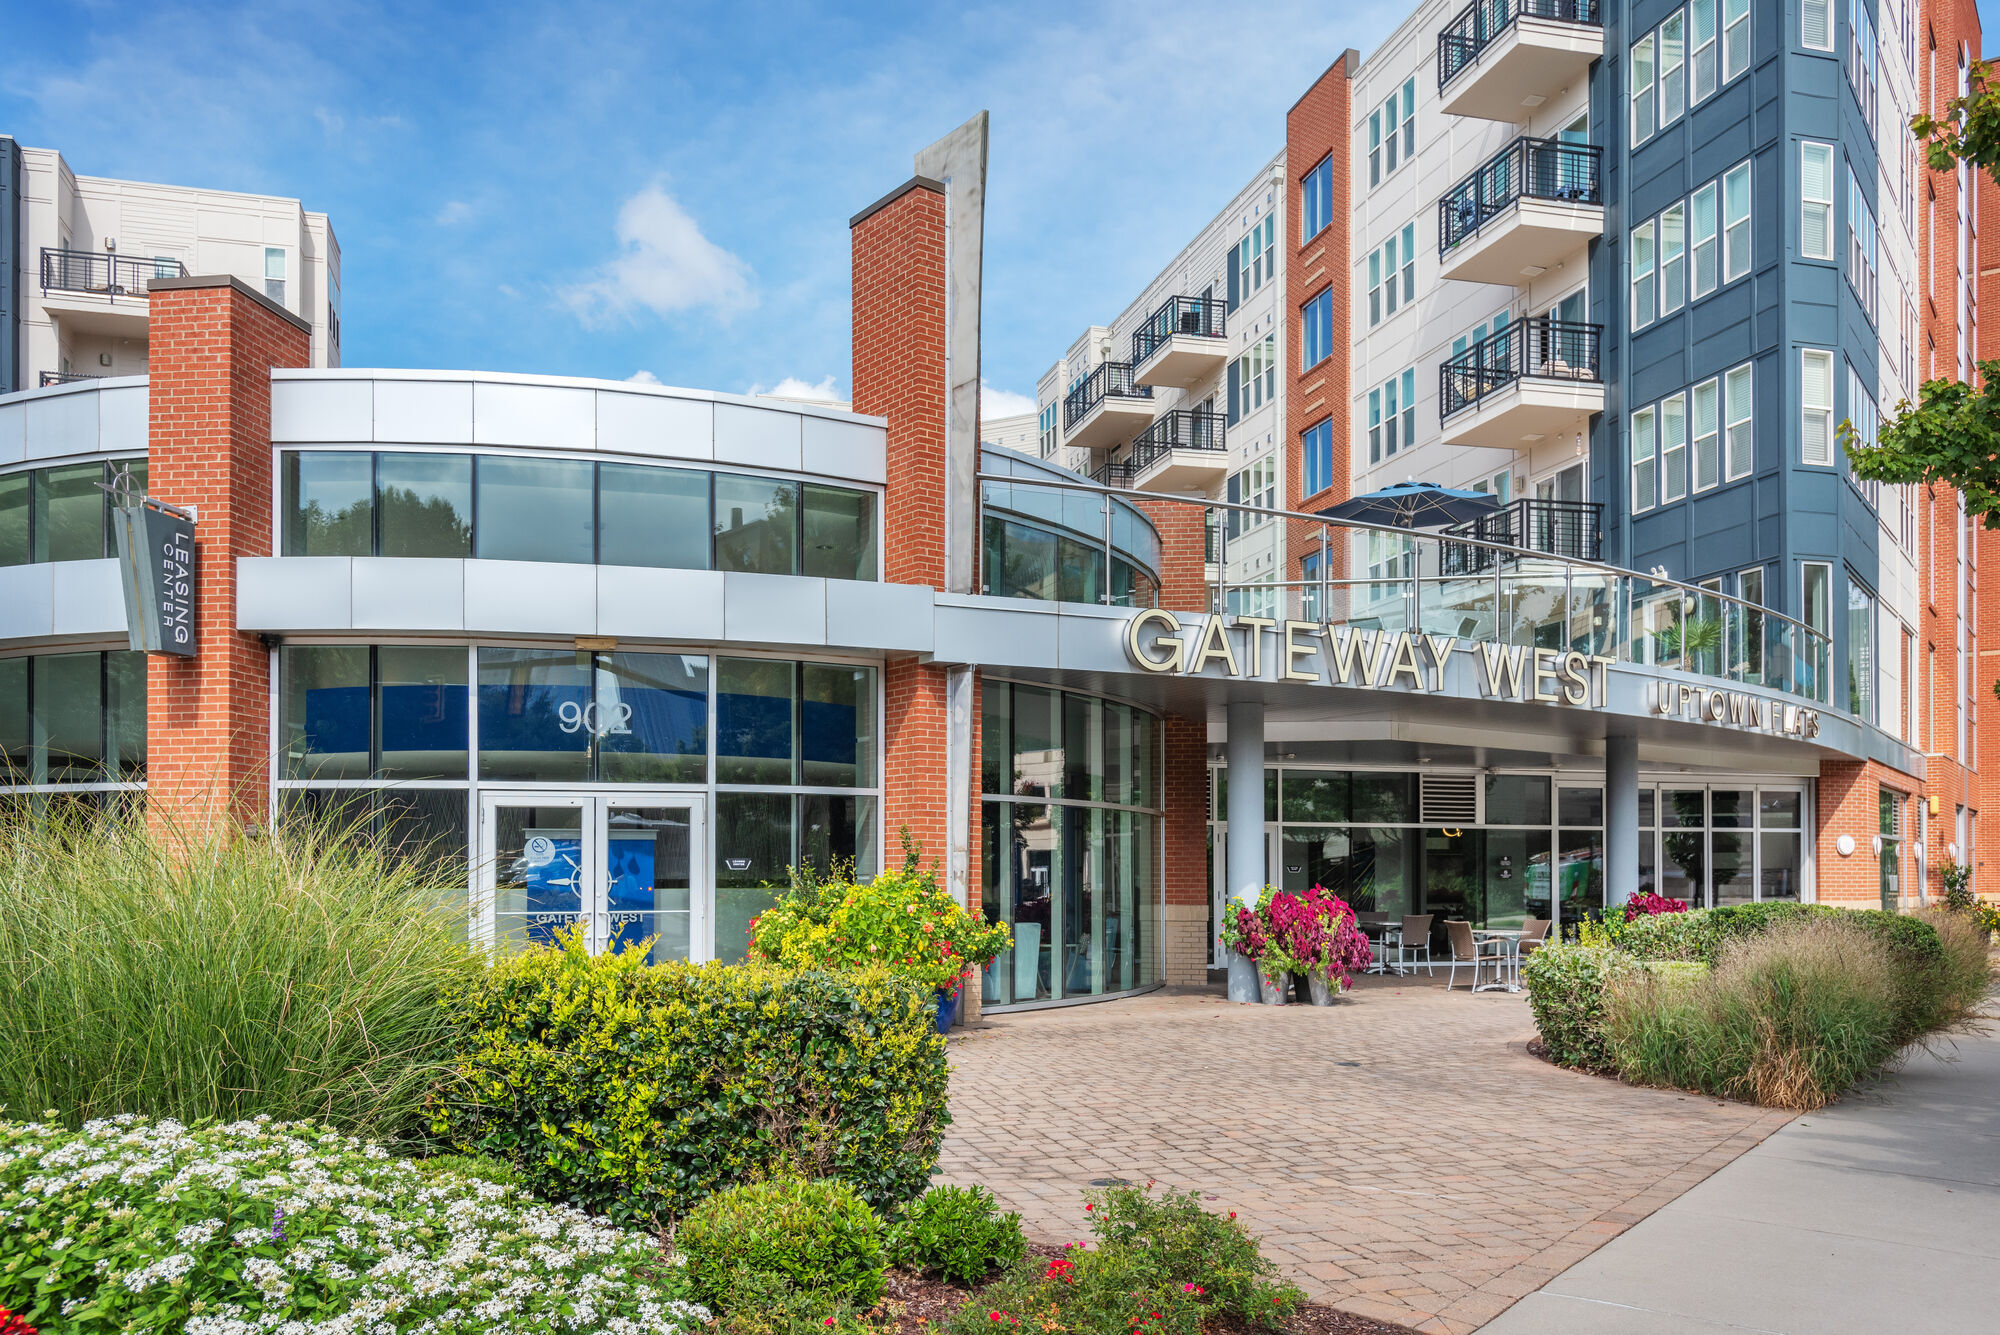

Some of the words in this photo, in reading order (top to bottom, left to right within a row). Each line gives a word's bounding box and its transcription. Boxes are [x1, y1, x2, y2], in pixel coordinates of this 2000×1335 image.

[163, 543, 174, 627] CENTER
[175, 532, 189, 644] LEASING
[1126, 608, 1457, 691] GATEWAY
[1475, 640, 1617, 707] WEST
[1654, 681, 1761, 727] UPTOWN
[1770, 701, 1820, 738] FLATS
